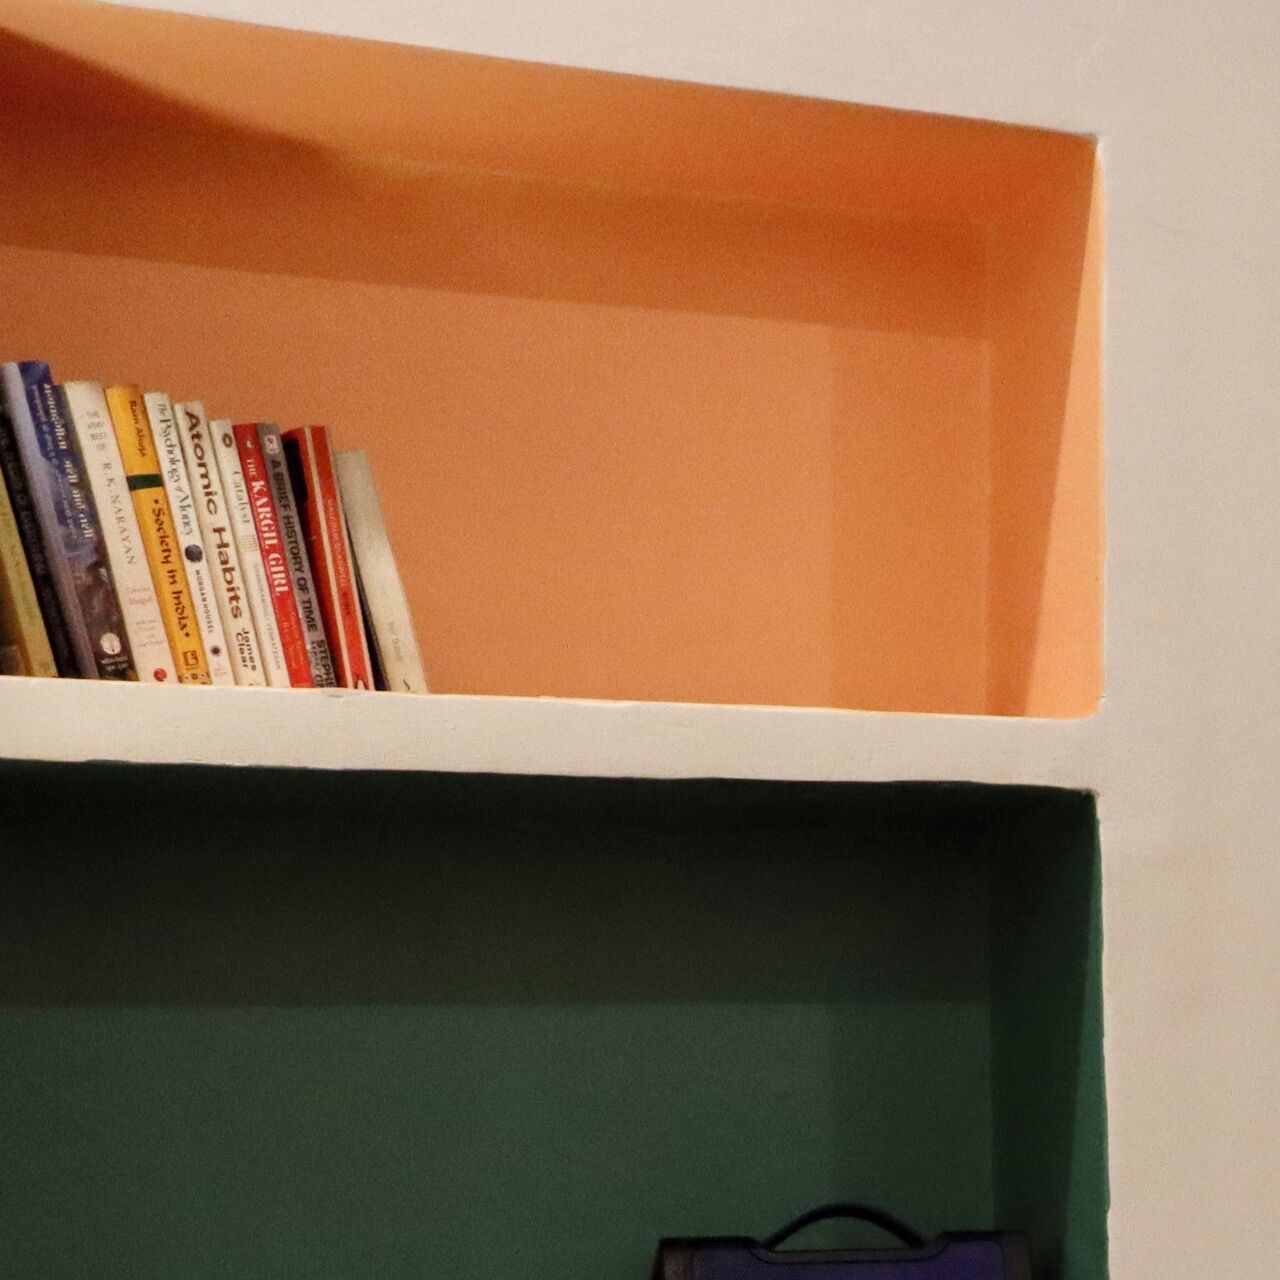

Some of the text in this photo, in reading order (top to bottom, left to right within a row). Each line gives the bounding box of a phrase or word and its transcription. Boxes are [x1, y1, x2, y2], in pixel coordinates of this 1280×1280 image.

[157, 403, 167, 417] The
[134, 427, 147, 458] Ahuja
[159, 418, 182, 483] Psychology
[270, 459, 281, 469] A
[177, 491, 193, 536] Money
[185, 411, 243, 620] Atomic Habits
[232, 471, 250, 524] Catalyst
[272, 472, 292, 513] BRIEF
[111, 494, 137, 566] NARAYAN
[246, 459, 290, 596] THE KARGIL GIRL
[283, 514, 306, 574] HISTORY
[152, 507, 189, 632] Society in India
[296, 577, 309, 595] OF
[195, 569, 214, 634] MORGAN HOUSEL
[301, 598, 318, 633] TIME
[235, 632, 249, 669] Clear
[241, 628, 257, 672] James
[316, 640, 336, 688] STEPHE
